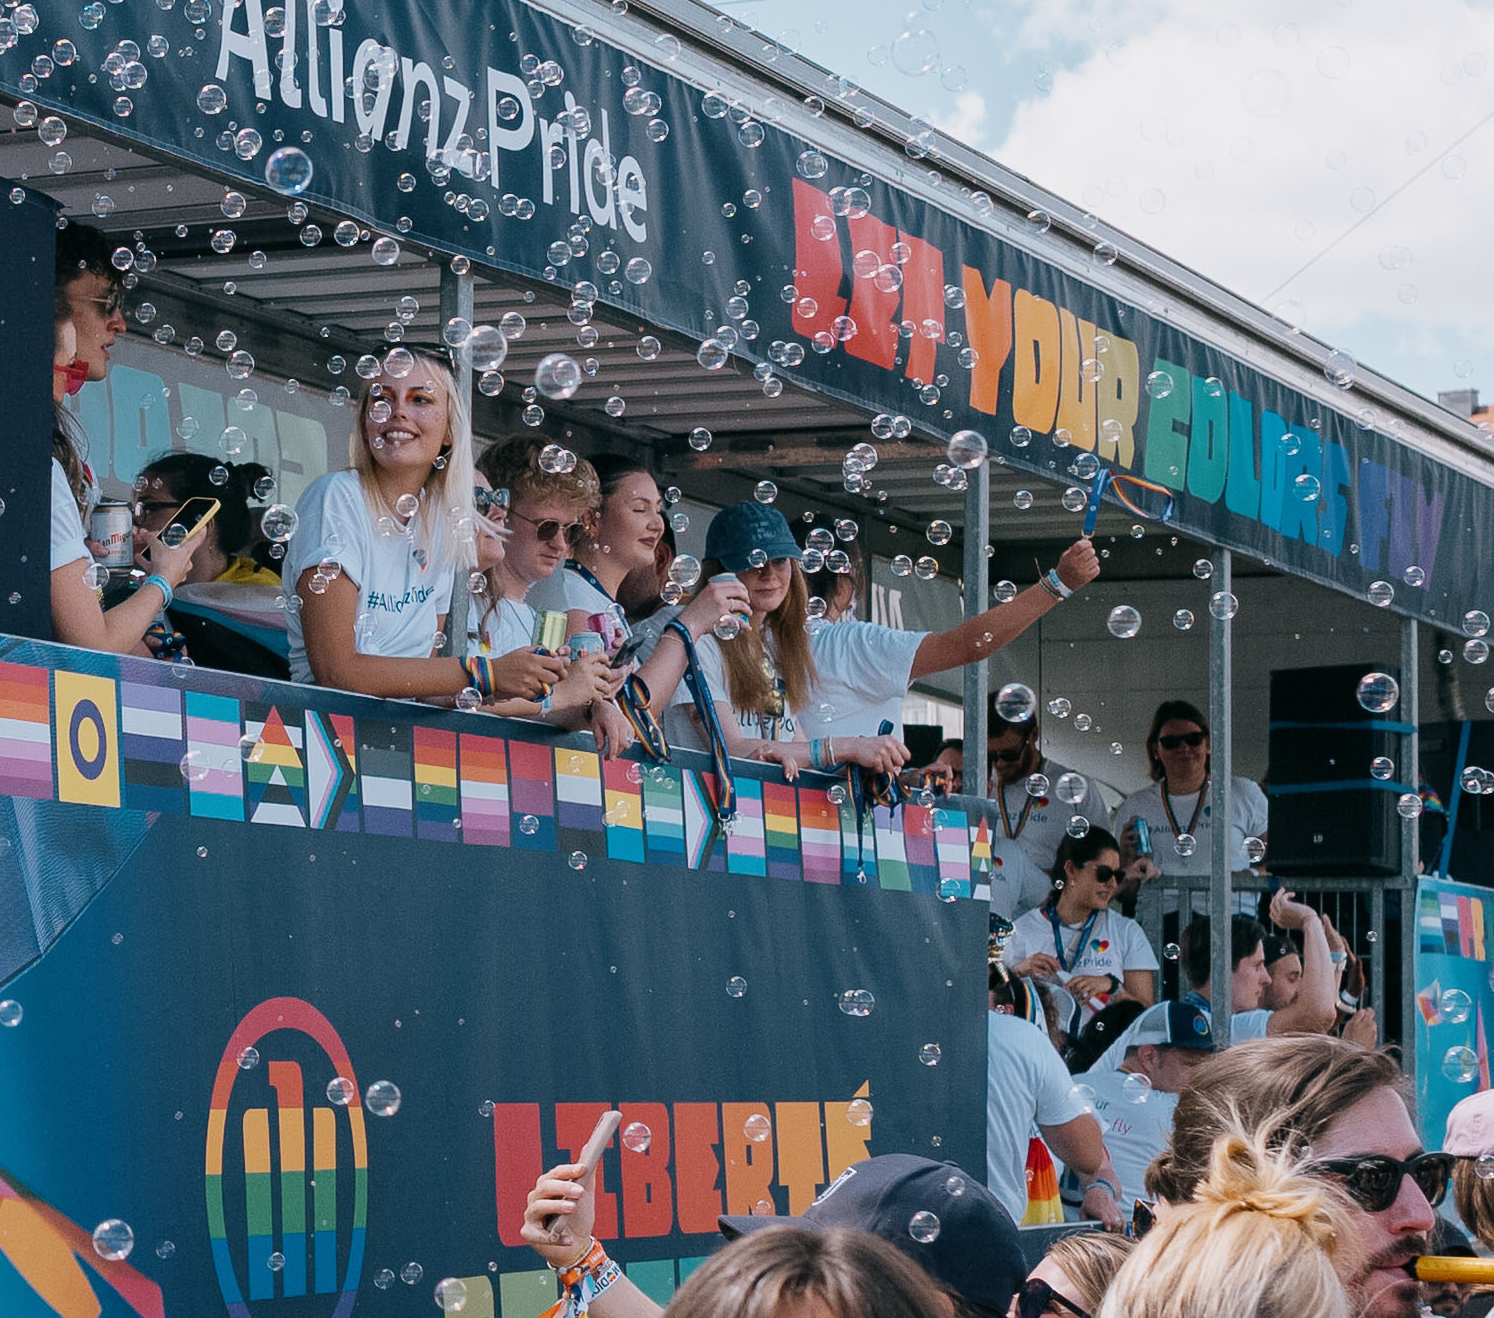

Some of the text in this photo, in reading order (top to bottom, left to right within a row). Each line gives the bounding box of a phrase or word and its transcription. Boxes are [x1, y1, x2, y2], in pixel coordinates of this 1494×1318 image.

[791, 177, 1446, 592] LET YOUR COLORS FLY
